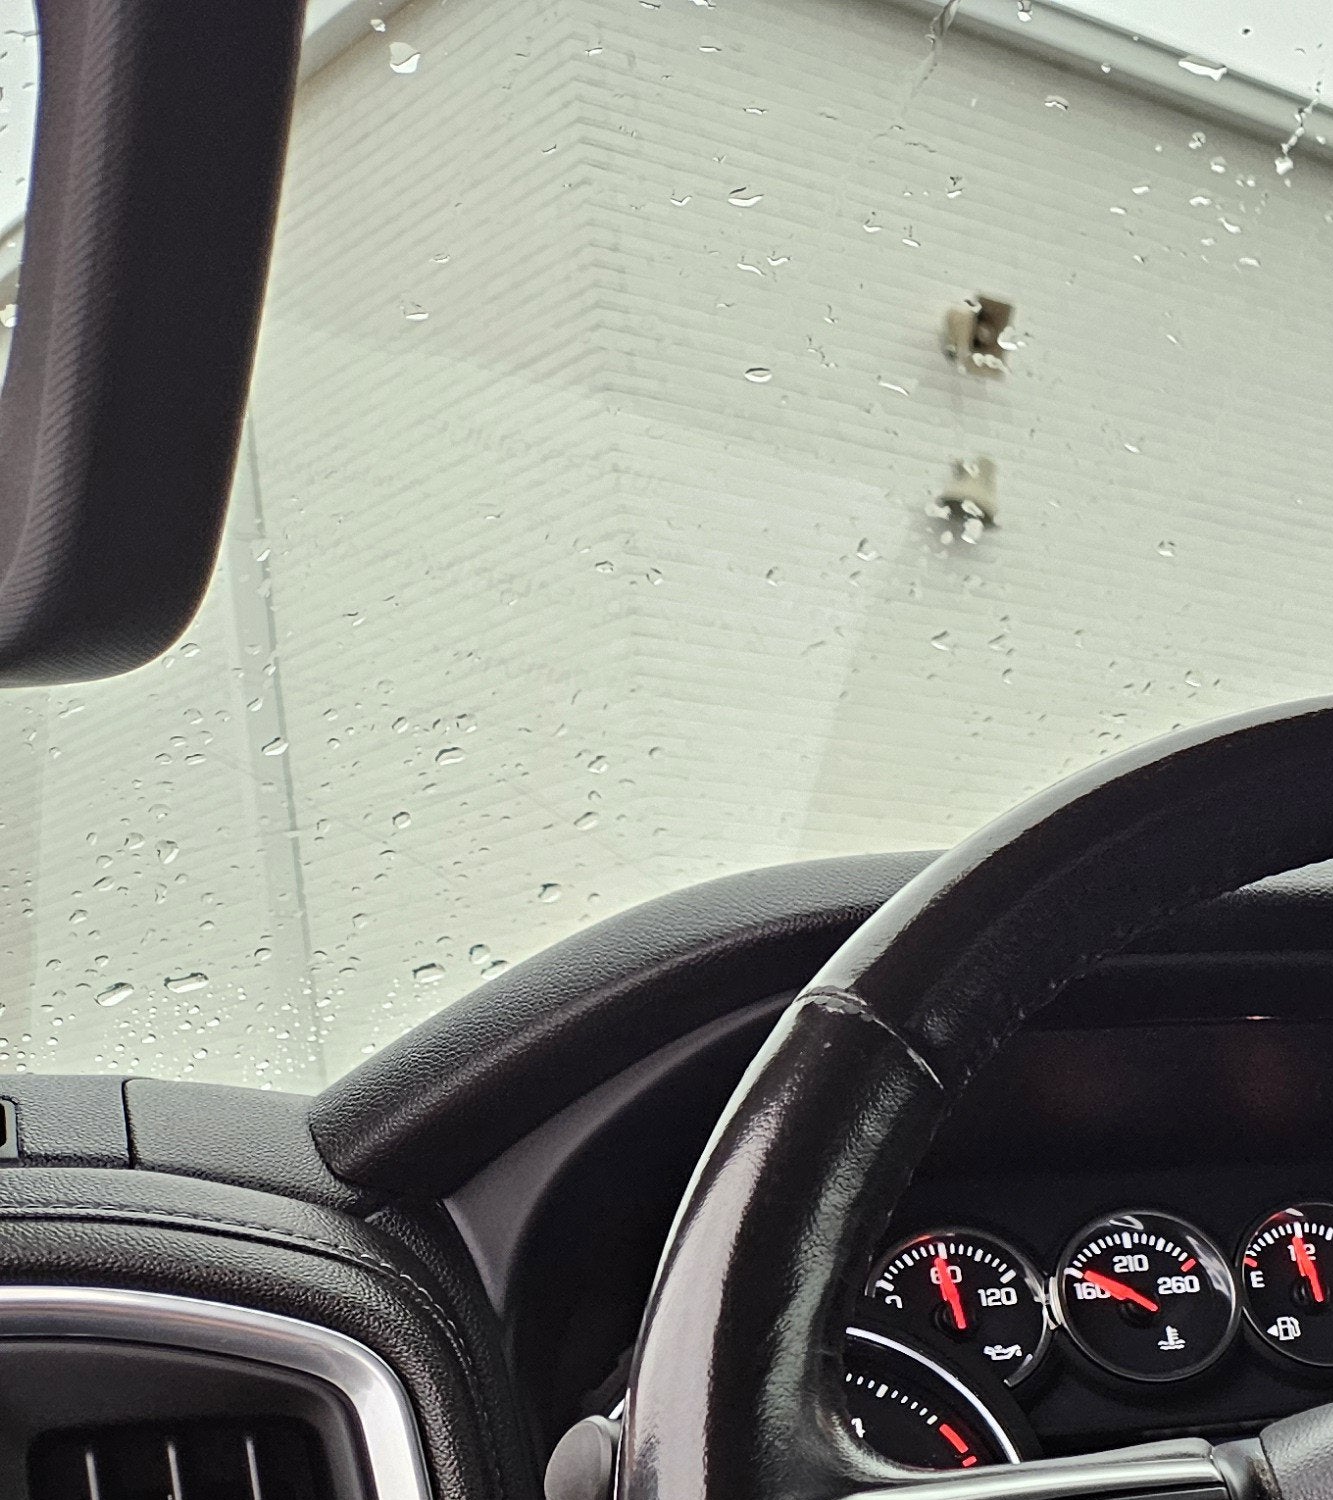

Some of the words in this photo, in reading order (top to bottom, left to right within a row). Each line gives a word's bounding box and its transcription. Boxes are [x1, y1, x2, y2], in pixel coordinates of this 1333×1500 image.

[1112, 1254, 1150, 1273] 210
[1156, 1275, 1201, 1296] 260
[1249, 1270, 1265, 1289] E
[978, 1287, 1018, 1307] 120
